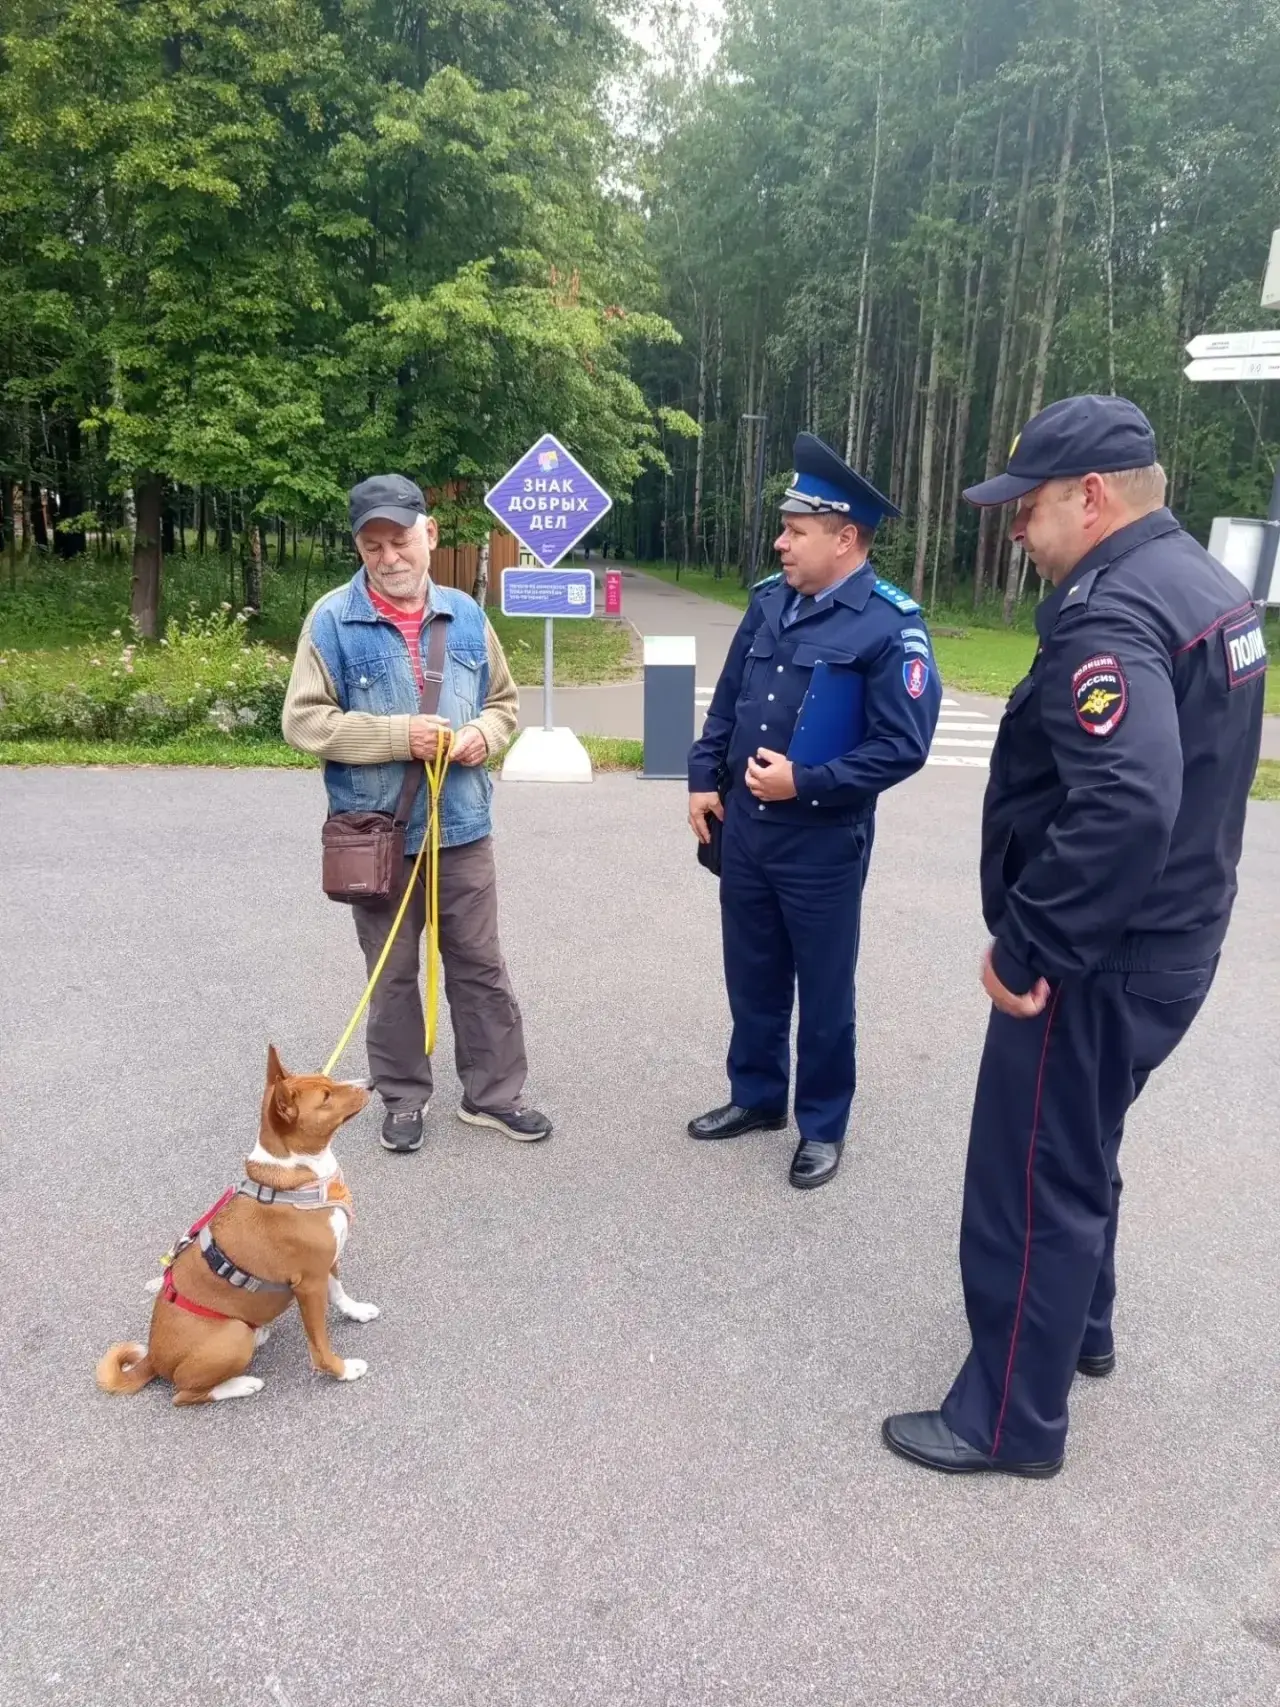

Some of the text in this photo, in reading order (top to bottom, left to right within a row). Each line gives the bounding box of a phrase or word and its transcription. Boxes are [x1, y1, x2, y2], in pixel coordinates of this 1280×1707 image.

[523, 478, 574, 493] ЗНАК
[508, 496, 589, 512] ДОБРЫХ
[529, 514, 567, 531] ДЕЛ
[1073, 657, 1113, 682] ПОЛИЦИЯ
[1077, 674, 1117, 698] РОССИЯ
